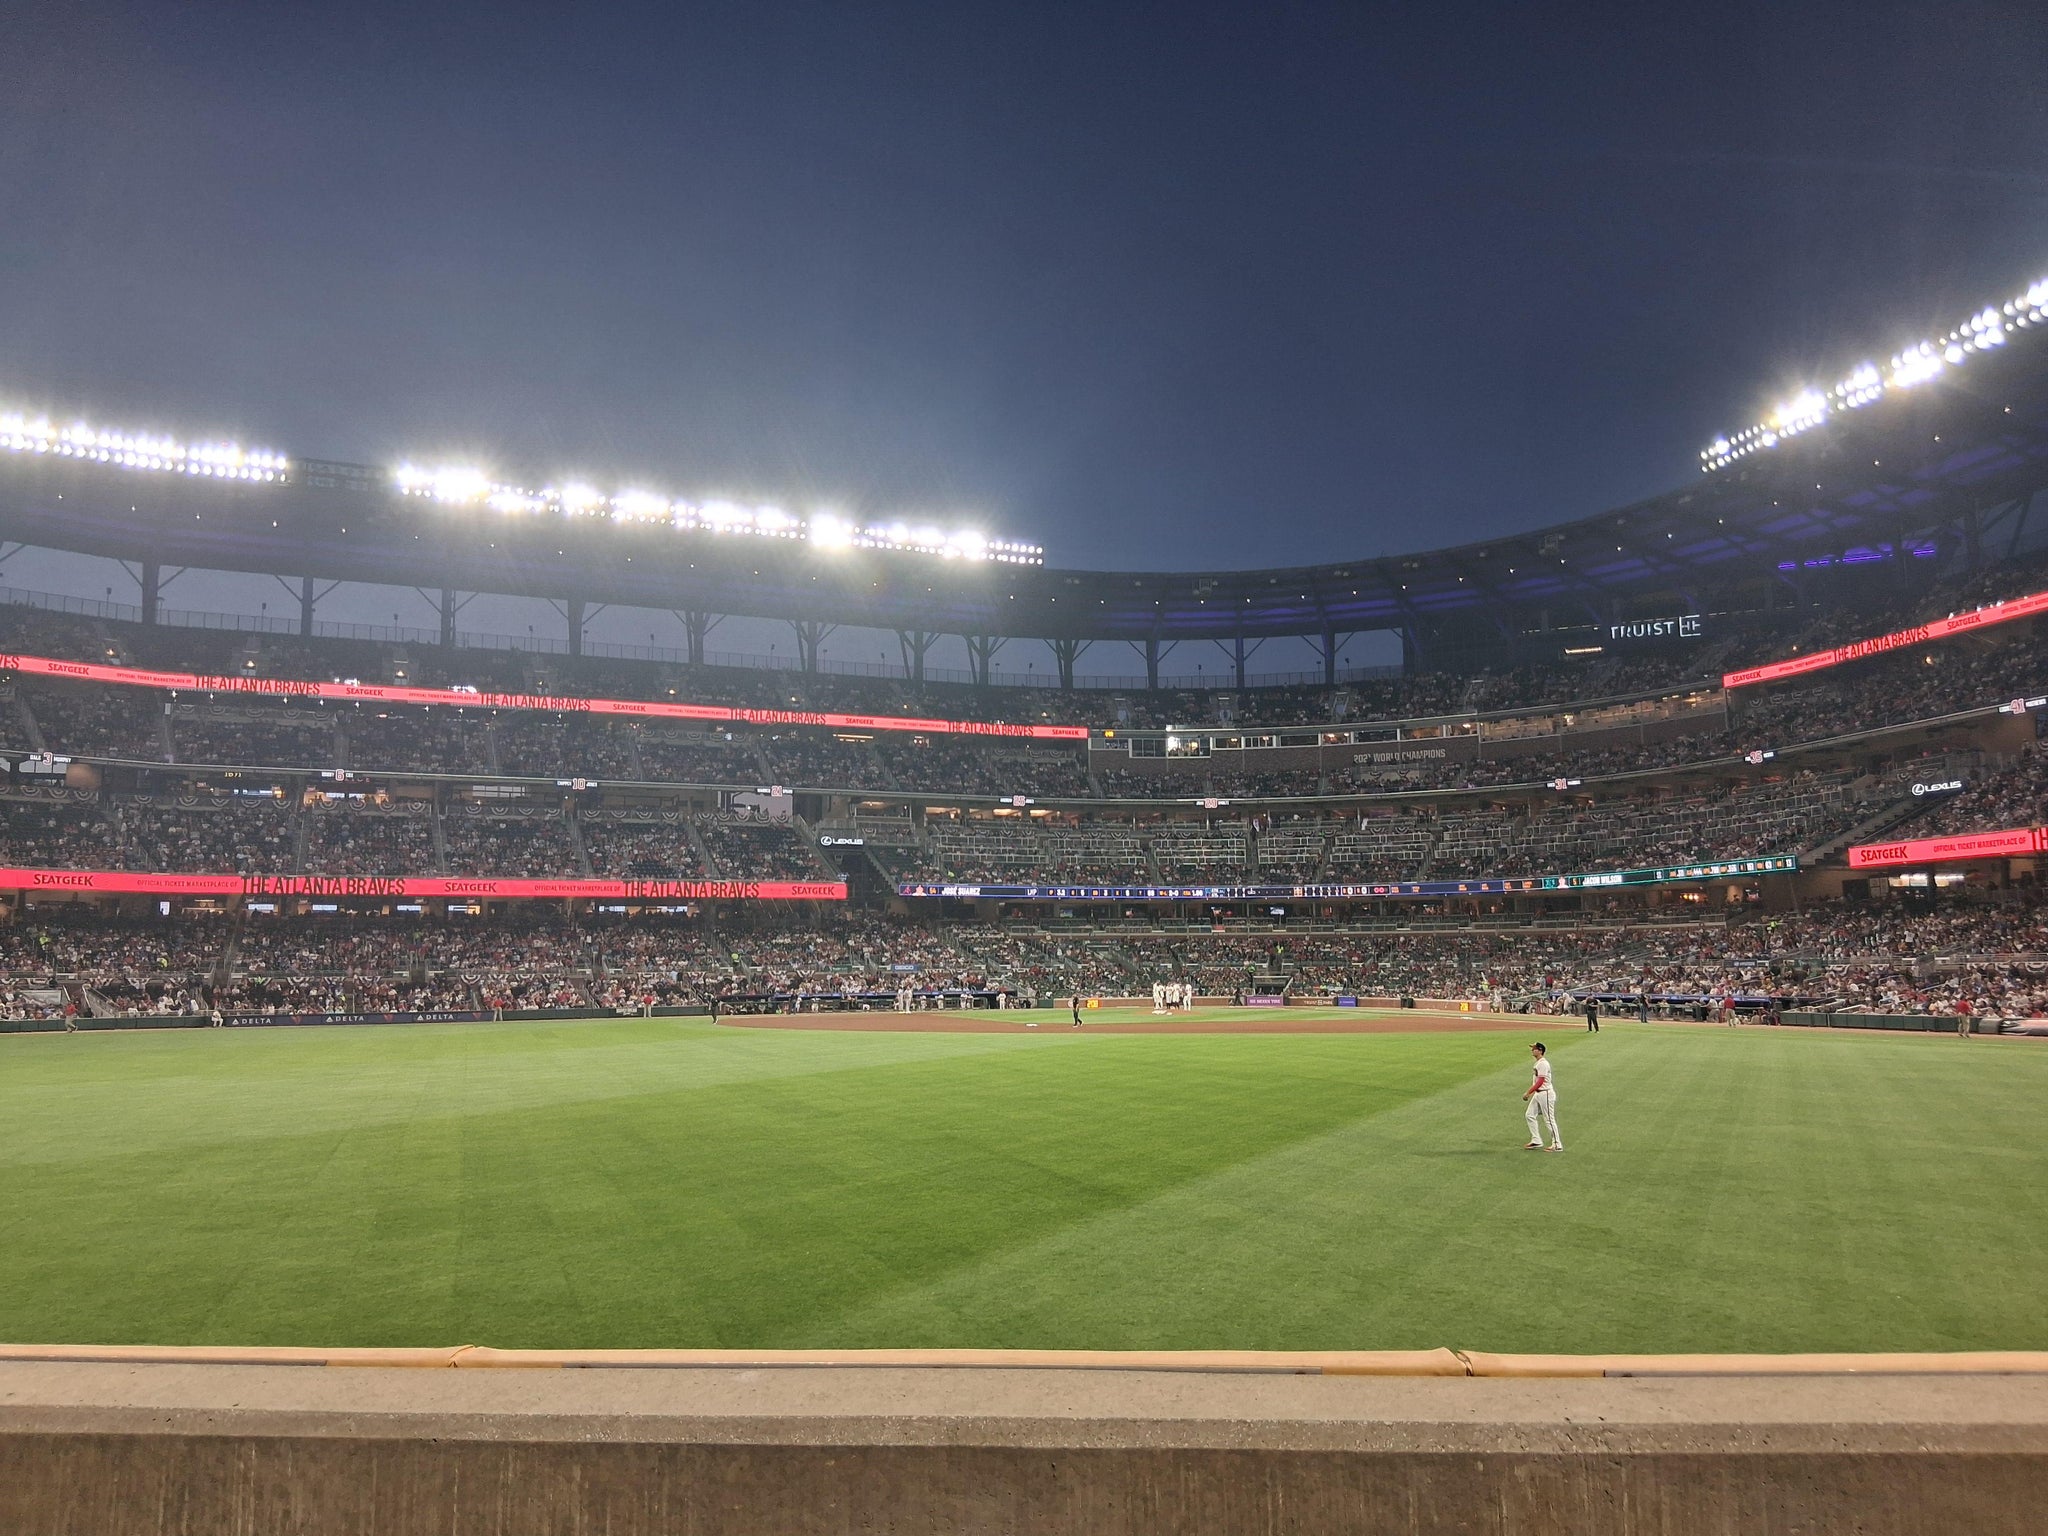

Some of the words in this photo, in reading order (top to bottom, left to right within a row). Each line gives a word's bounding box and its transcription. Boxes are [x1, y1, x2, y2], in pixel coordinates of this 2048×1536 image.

[1947, 614, 1981, 630] SEATGEEK
[1610, 621, 1675, 639] TRUIST
[1833, 646, 1850, 663] THE
[1849, 636, 1891, 660] ATLANTA
[1891, 625, 1929, 647] BRAVES
[48, 662, 89, 675] SEATGEEK
[1732, 670, 1762, 683] SEATGEEK
[195, 675, 217, 689] THE
[219, 676, 274, 693] ATLANTA
[275, 679, 321, 695] BRAVES
[346, 687, 384, 697] SEATGEEK
[481, 693, 500, 707] THE
[501, 694, 548, 709] ATLANTA
[550, 696, 591, 711] BRAVES
[613, 703, 646, 712] SEATGEEK
[2011, 698, 2026, 715] 41
[729, 708, 747, 721] THE
[749, 709, 789, 724] ATLANTA
[791, 711, 826, 725] BRAVES
[845, 717, 874, 726] SEATGEEK
[949, 721, 963, 734] THE
[964, 721, 1000, 735] ATLANTA
[1001, 723, 1034, 737] BRAVES
[1052, 728, 1079, 736] SEATGEEK
[42, 752, 53, 766] 3
[1402, 749, 1446, 761] CHAMPIONS
[335, 769, 345, 781] 6
[572, 778, 586, 790] 10
[1555, 778, 1567, 790] 31
[1925, 780, 1962, 792] LEXUS
[1933, 843, 1956, 853] OFFICIAL
[1957, 841, 1976, 850] TICKET
[1977, 838, 2017, 849] MARKETPLACE
[2019, 836, 2026, 845] OF
[1860, 845, 1908, 863] SEATGEEK
[33, 873, 94, 887] SEATGEEK
[137, 879, 162, 887] OFFICIAL
[241, 876, 270, 895] THE
[273, 876, 342, 895] ATLANTA
[348, 877, 406, 896] BRAVES
[1582, 876, 1600, 886] JACOB
[1600, 874, 1622, 885] WILSON
[444, 881, 497, 893] SEATGEEK
[534, 884, 557, 892] OFFICIAL
[577, 884, 613, 892] MARKETPLACE
[623, 881, 648, 897] THE
[650, 881, 708, 898] ATLANTA
[711, 882, 760, 898] BRAVES
[791, 885, 835, 896] SEATGEEK
[241, 1017, 271, 1025] DELTA
